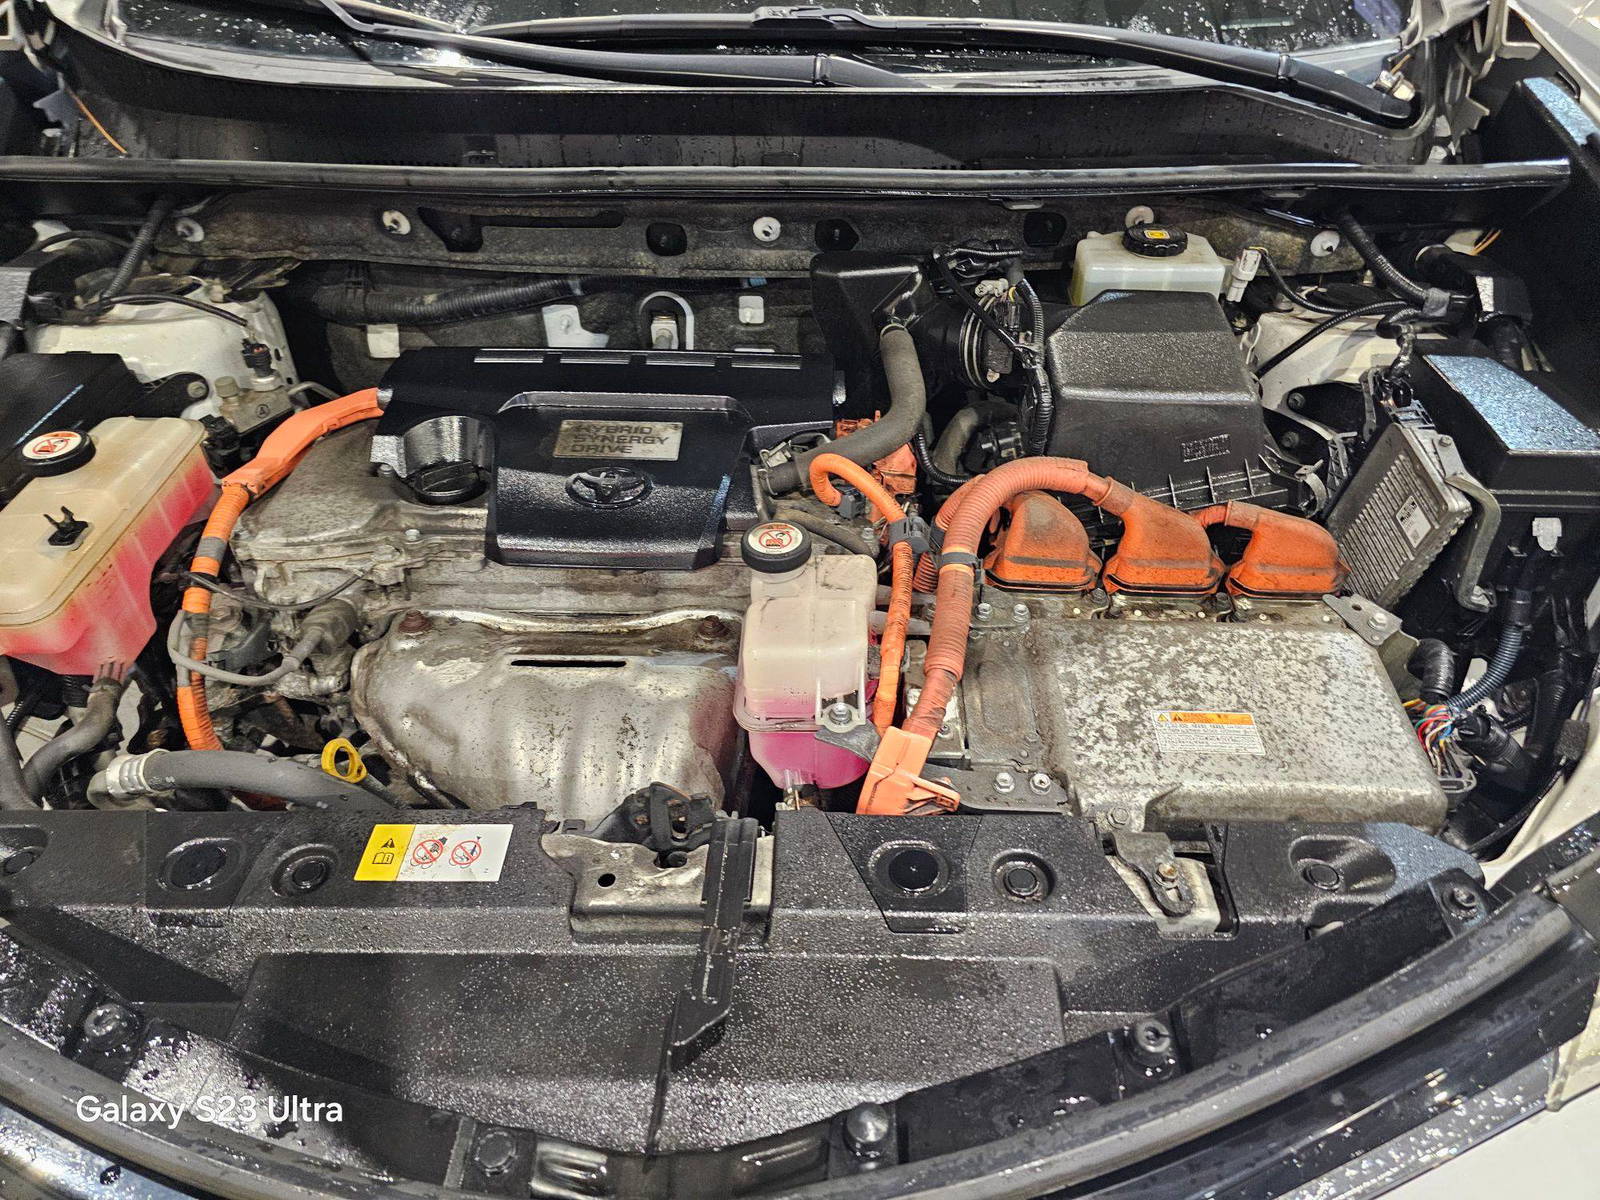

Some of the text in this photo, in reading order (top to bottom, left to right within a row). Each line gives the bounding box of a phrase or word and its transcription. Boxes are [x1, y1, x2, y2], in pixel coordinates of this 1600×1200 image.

[572, 424, 653, 435] HYBRID
[573, 434, 669, 445] SYNERGY
[570, 444, 633, 454] DRIVE
